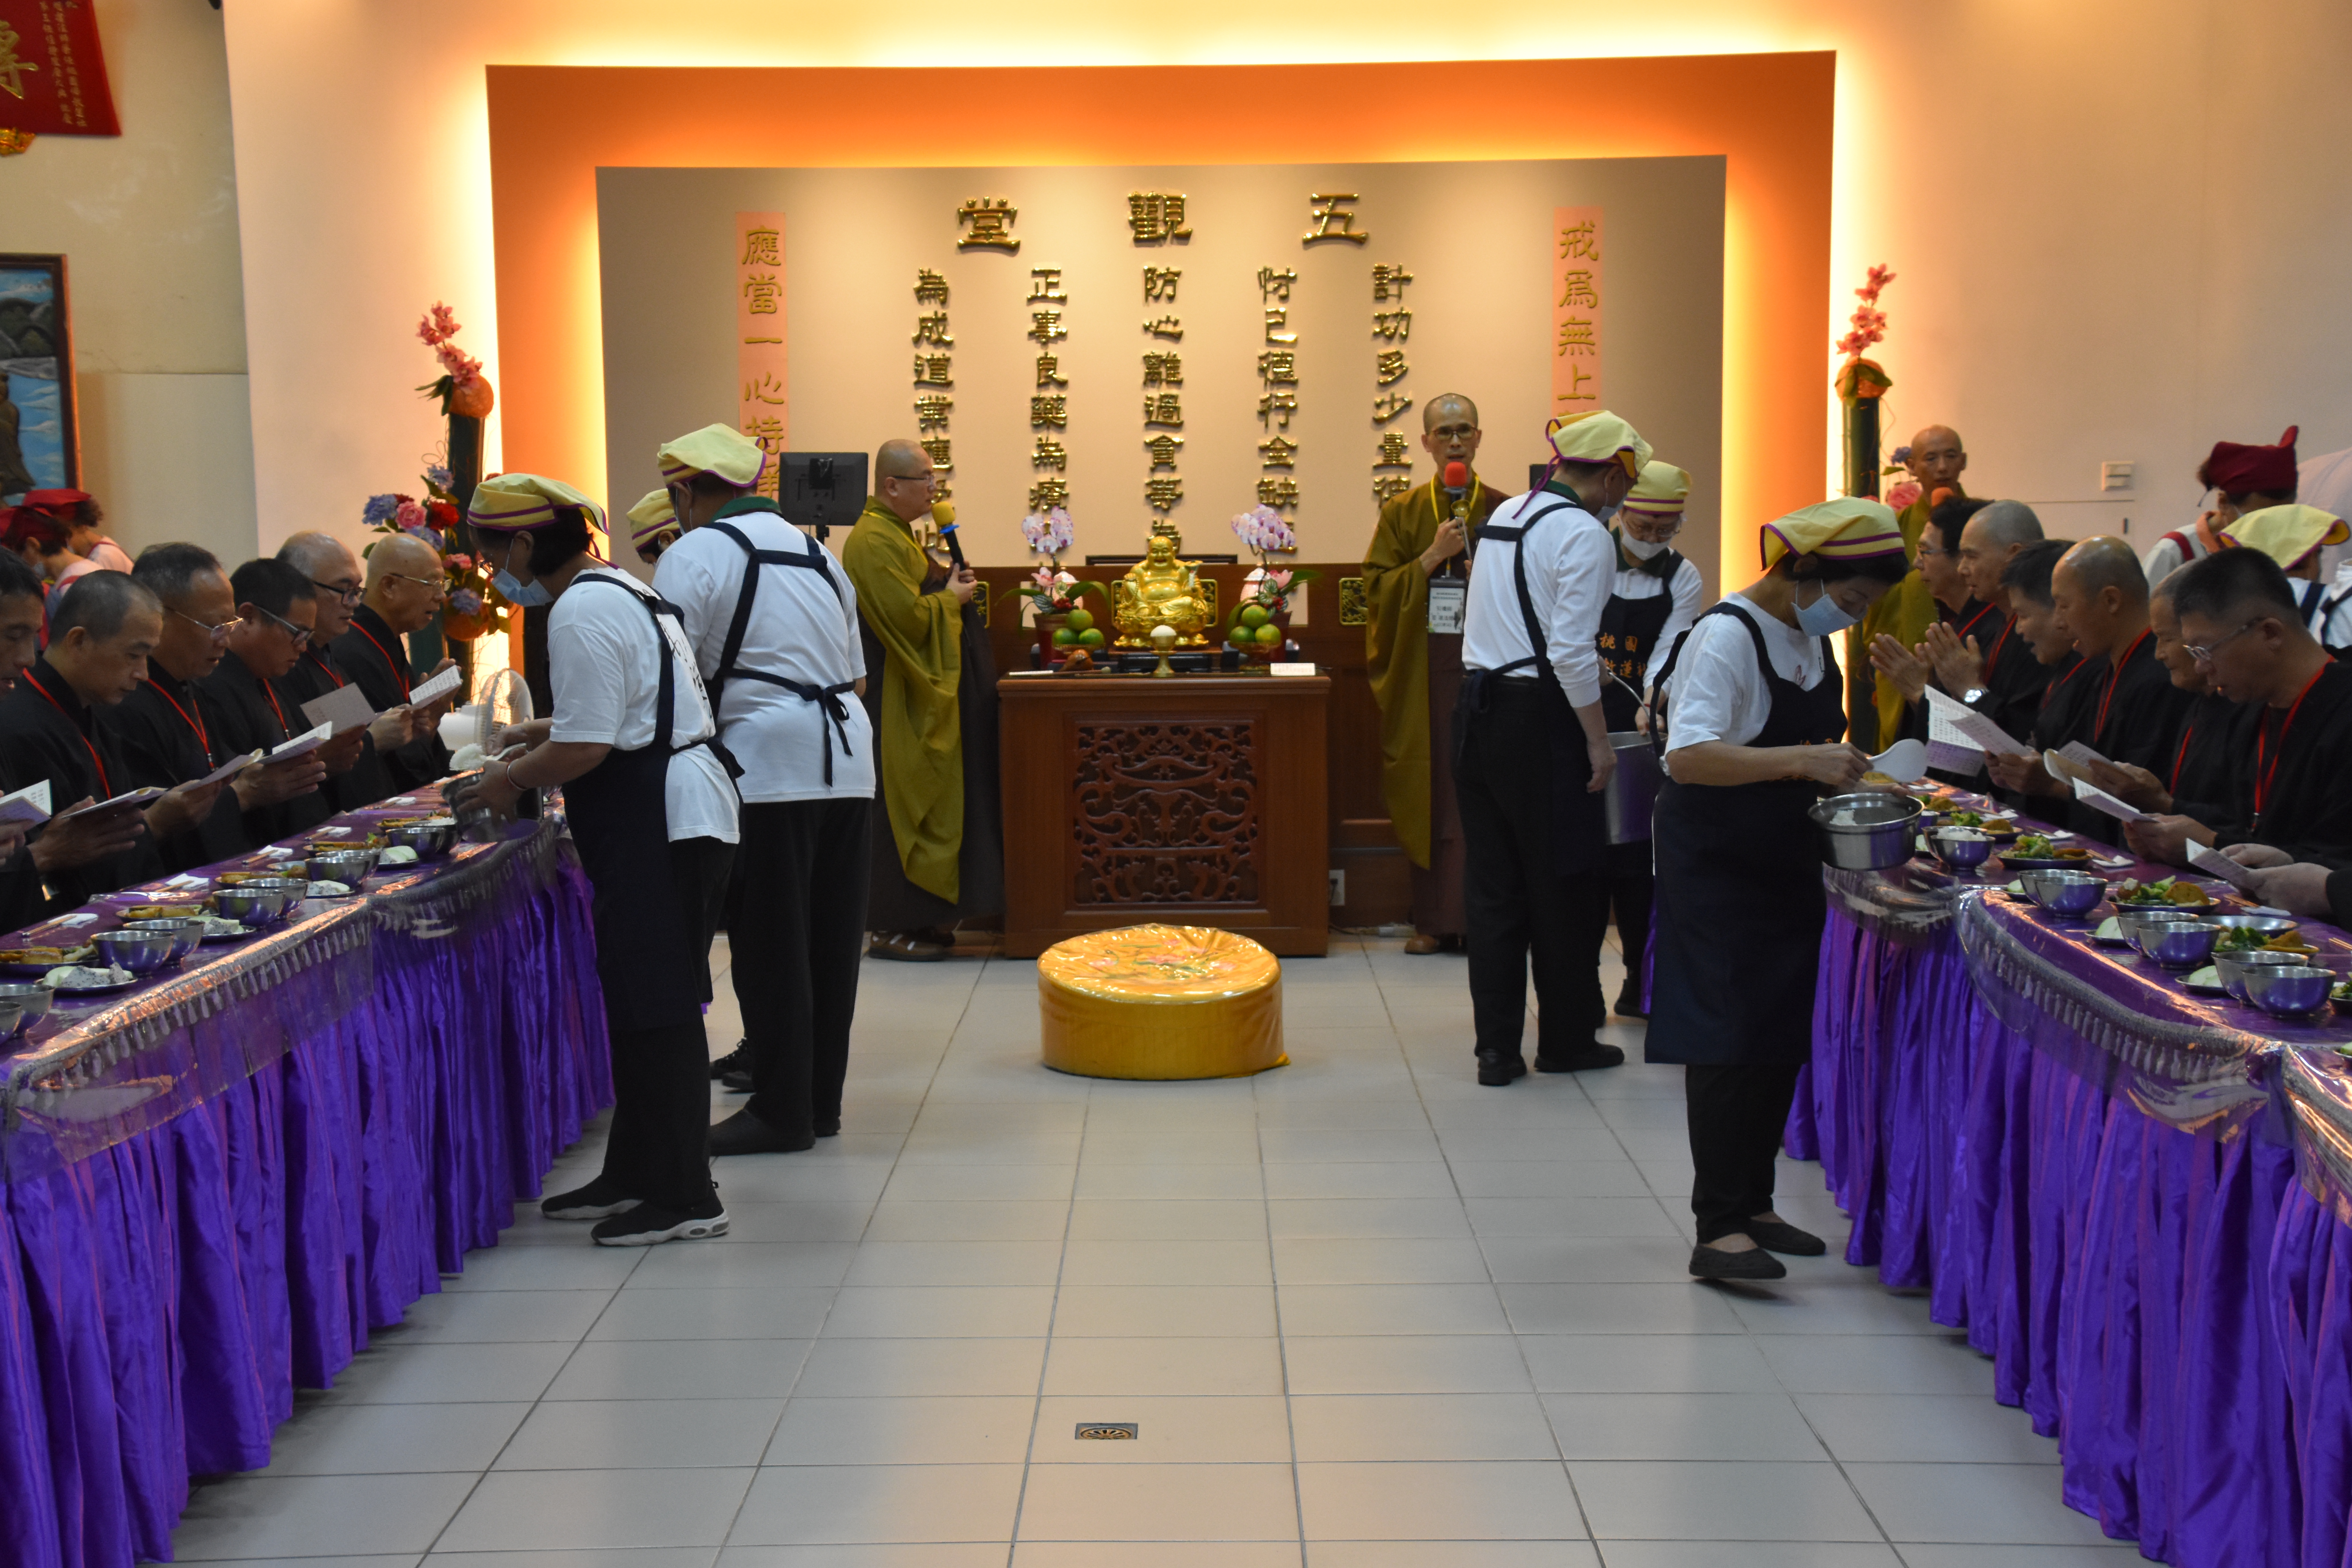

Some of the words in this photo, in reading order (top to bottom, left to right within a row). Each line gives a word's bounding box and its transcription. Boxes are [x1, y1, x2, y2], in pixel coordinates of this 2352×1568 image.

[1026, 267, 1070, 551] 正事良藥為療
[1257, 265, 1299, 554] 忖己德行全缺
[1557, 220, 1599, 417] 戒爲無上
